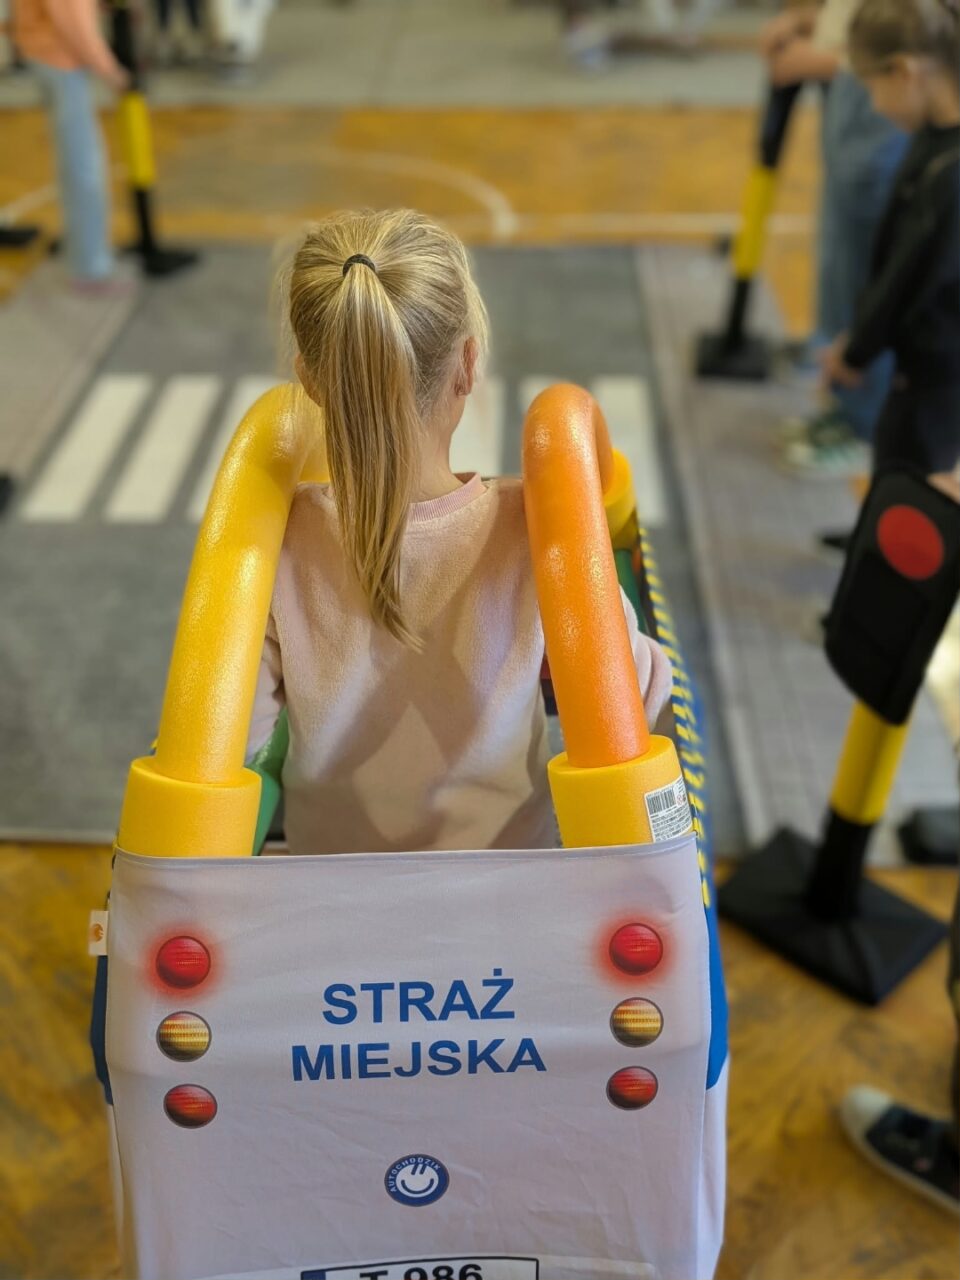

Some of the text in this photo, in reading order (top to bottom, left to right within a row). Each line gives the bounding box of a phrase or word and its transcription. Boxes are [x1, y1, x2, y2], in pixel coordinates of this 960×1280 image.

[322, 968, 515, 1025] STRAŻ
[292, 1038, 547, 1081] MIEJSKA
[388, 1157, 441, 1192] AUTOCHODZIK
